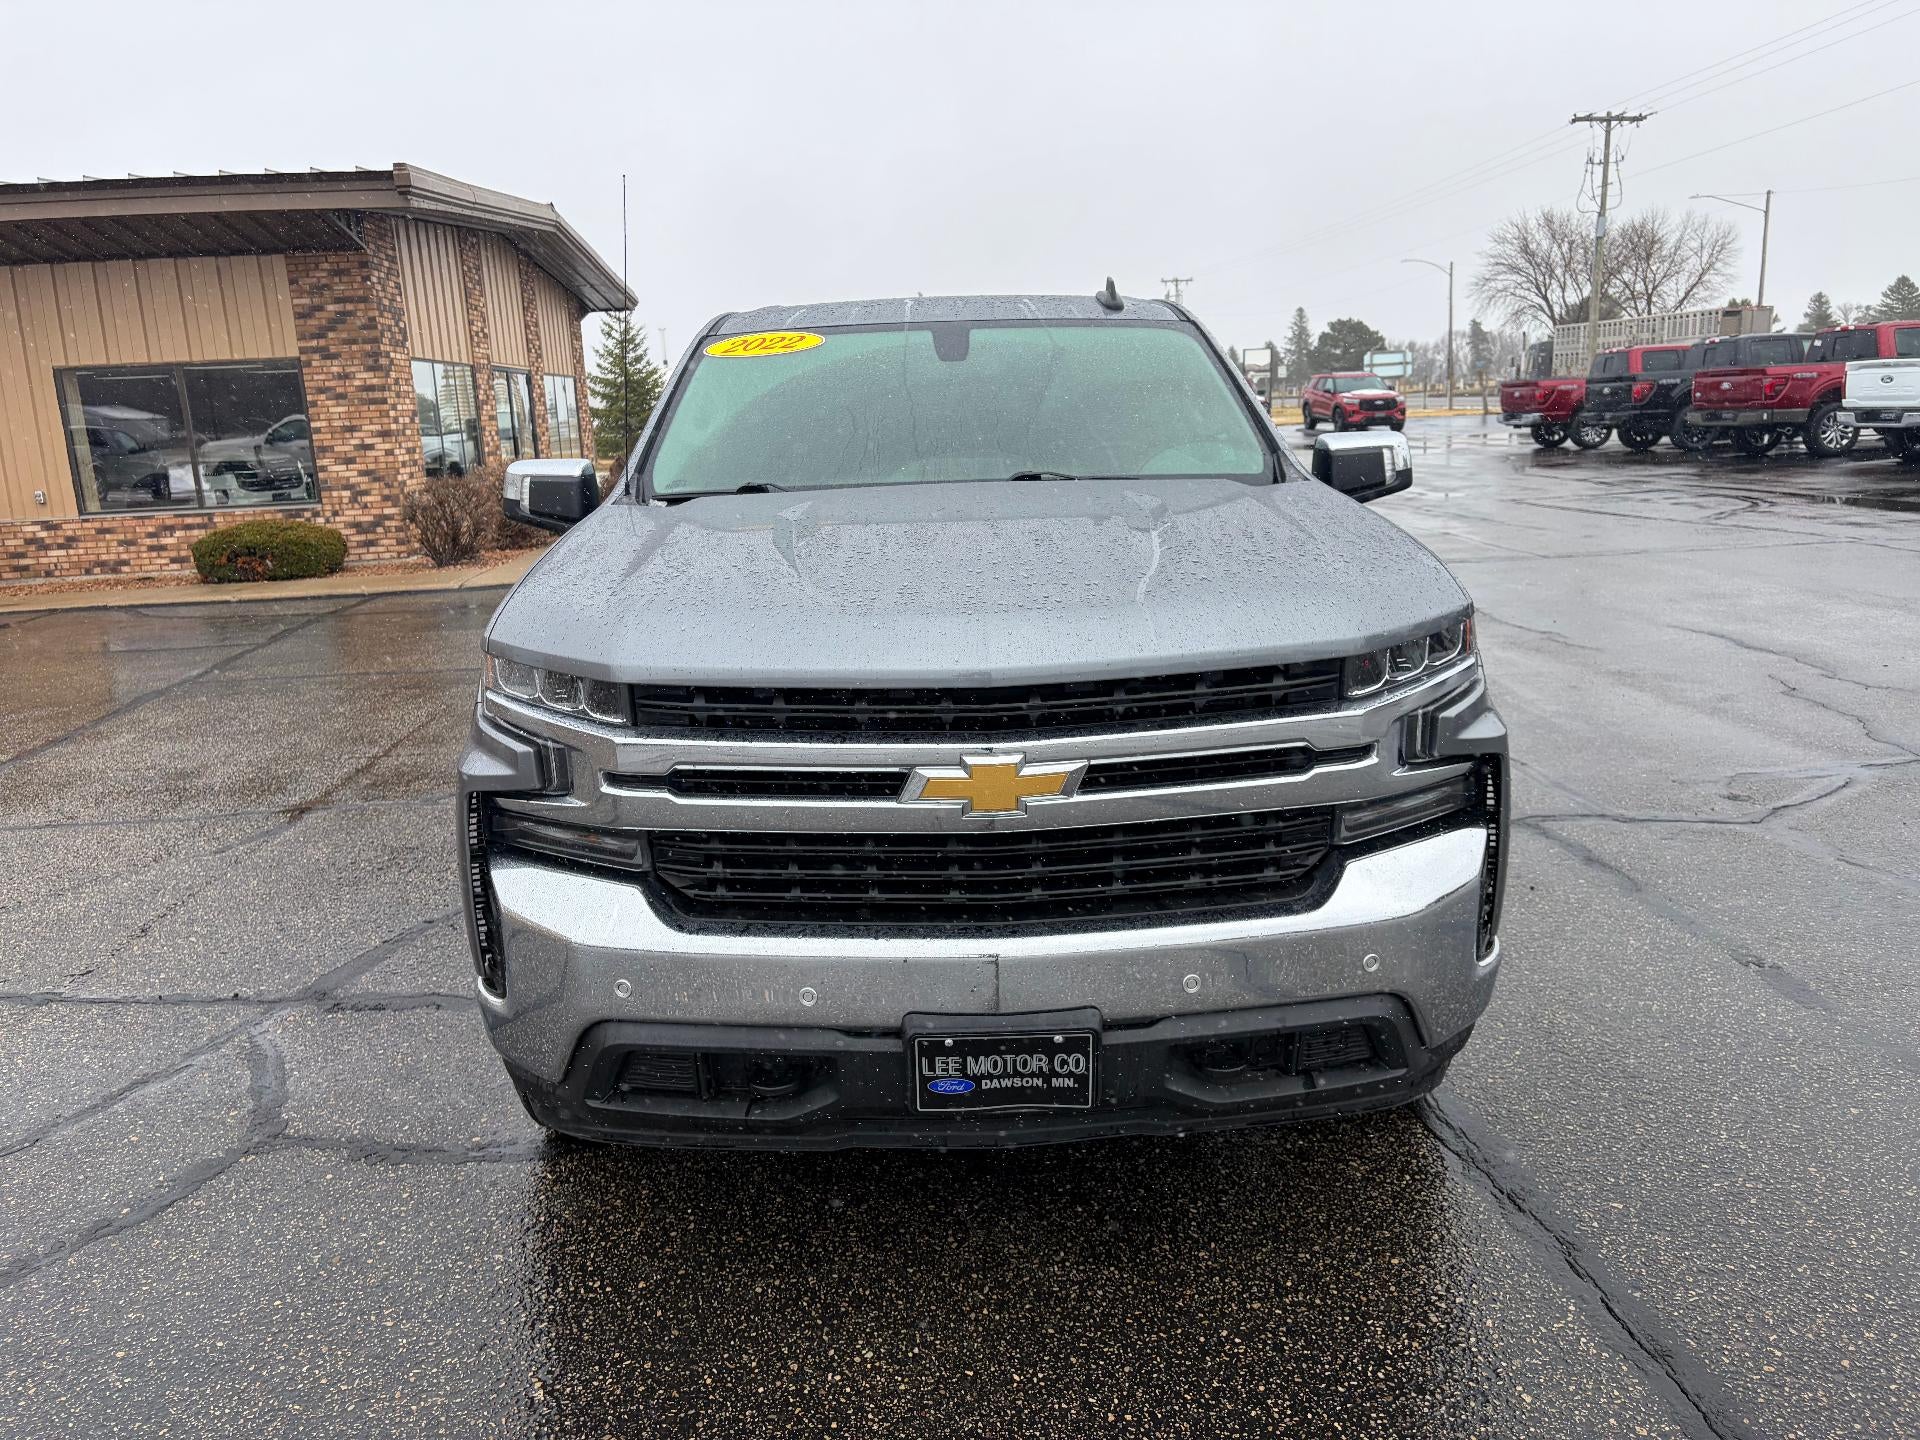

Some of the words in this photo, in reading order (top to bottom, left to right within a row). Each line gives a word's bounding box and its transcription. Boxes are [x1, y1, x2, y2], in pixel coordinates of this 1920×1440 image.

[721, 335, 806, 353] 2022
[921, 1056, 963, 1076] LEE
[967, 1053, 1049, 1076] MOTOR
[981, 1077, 1047, 1089] DAWSON,
[1051, 1077, 1079, 1088] MN.
